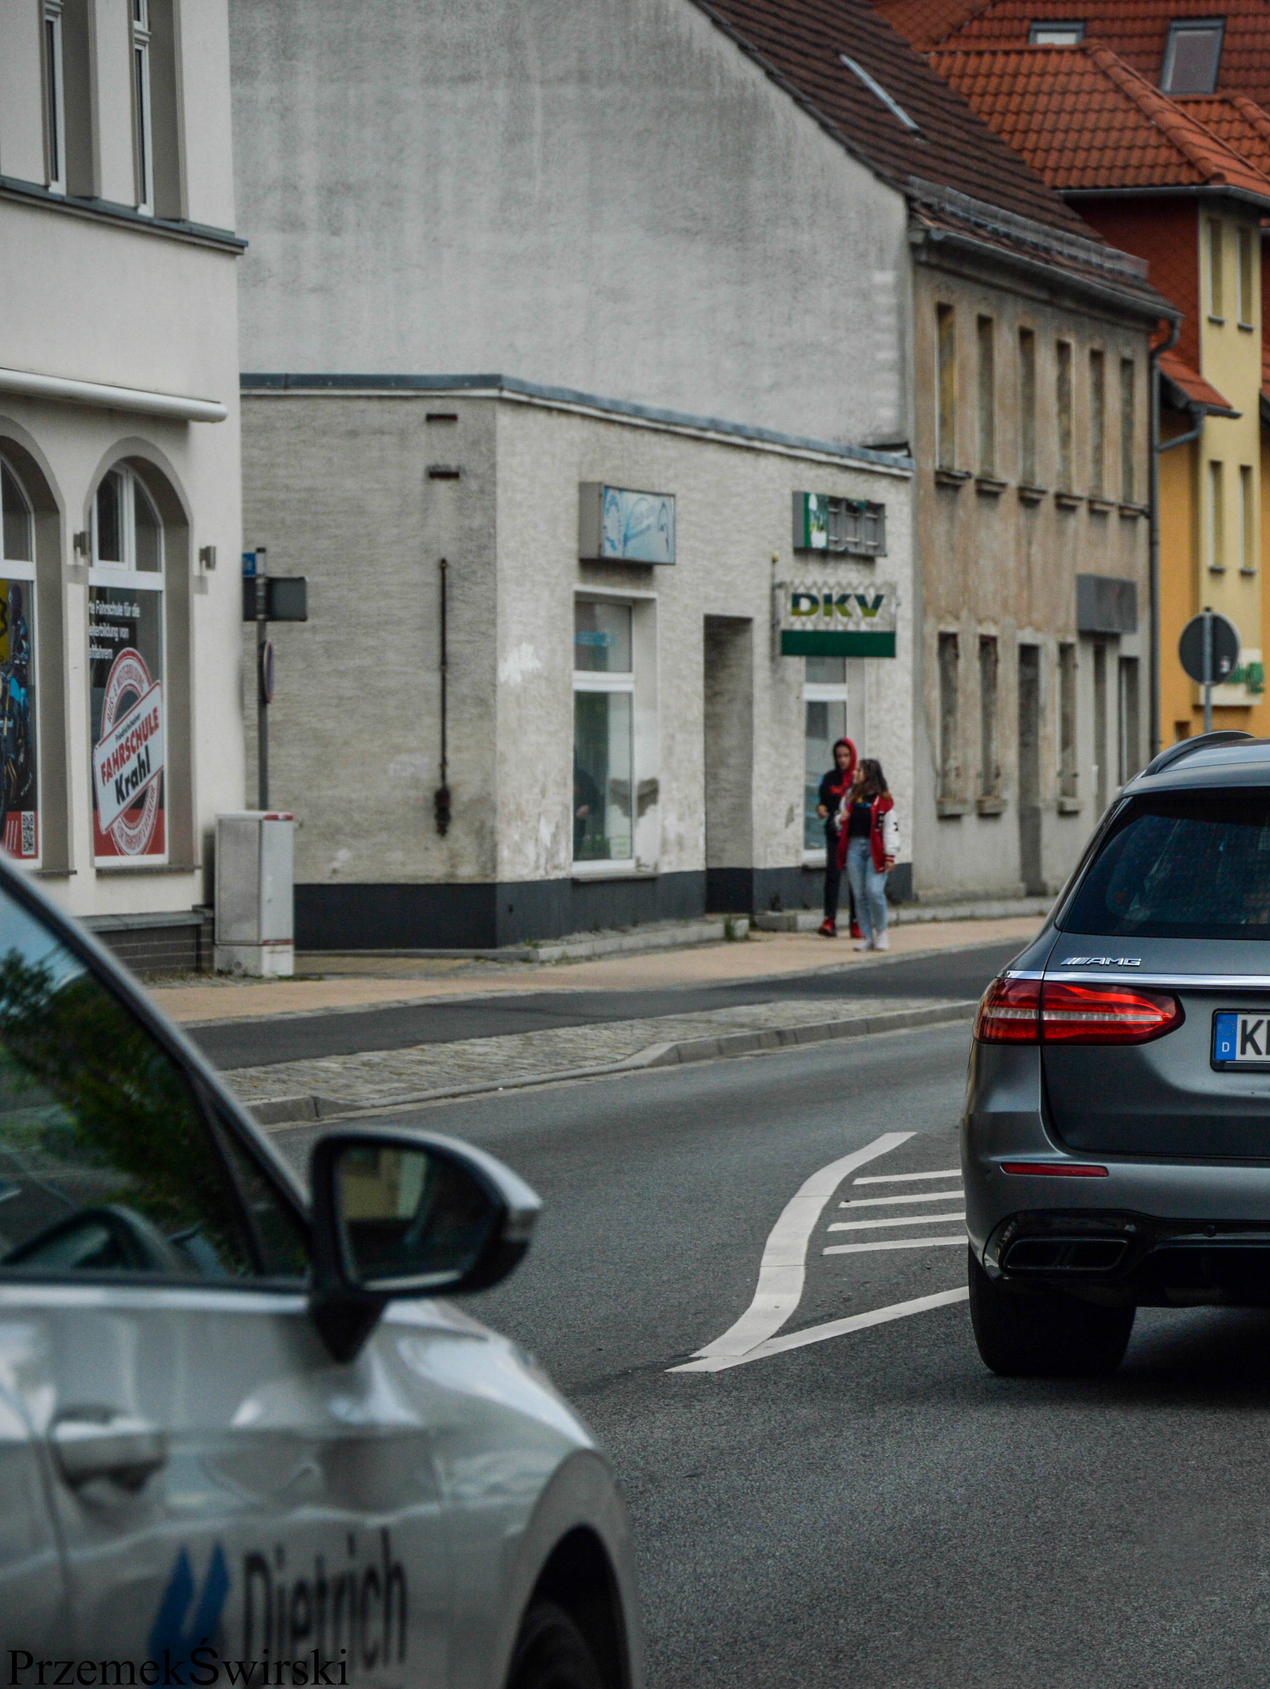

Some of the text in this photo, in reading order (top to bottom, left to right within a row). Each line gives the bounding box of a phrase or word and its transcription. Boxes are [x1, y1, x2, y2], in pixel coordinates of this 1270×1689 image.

[96, 600, 123, 616] Fahrschule
[791, 592, 885, 618] DKV
[101, 706, 160, 787] FAHRSCHULE
[114, 744, 151, 806] Krahl
[1085, 957, 1142, 967] AMG
[1221, 1041, 1230, 1053] D
[242, 1525, 408, 1684] Dietrich
